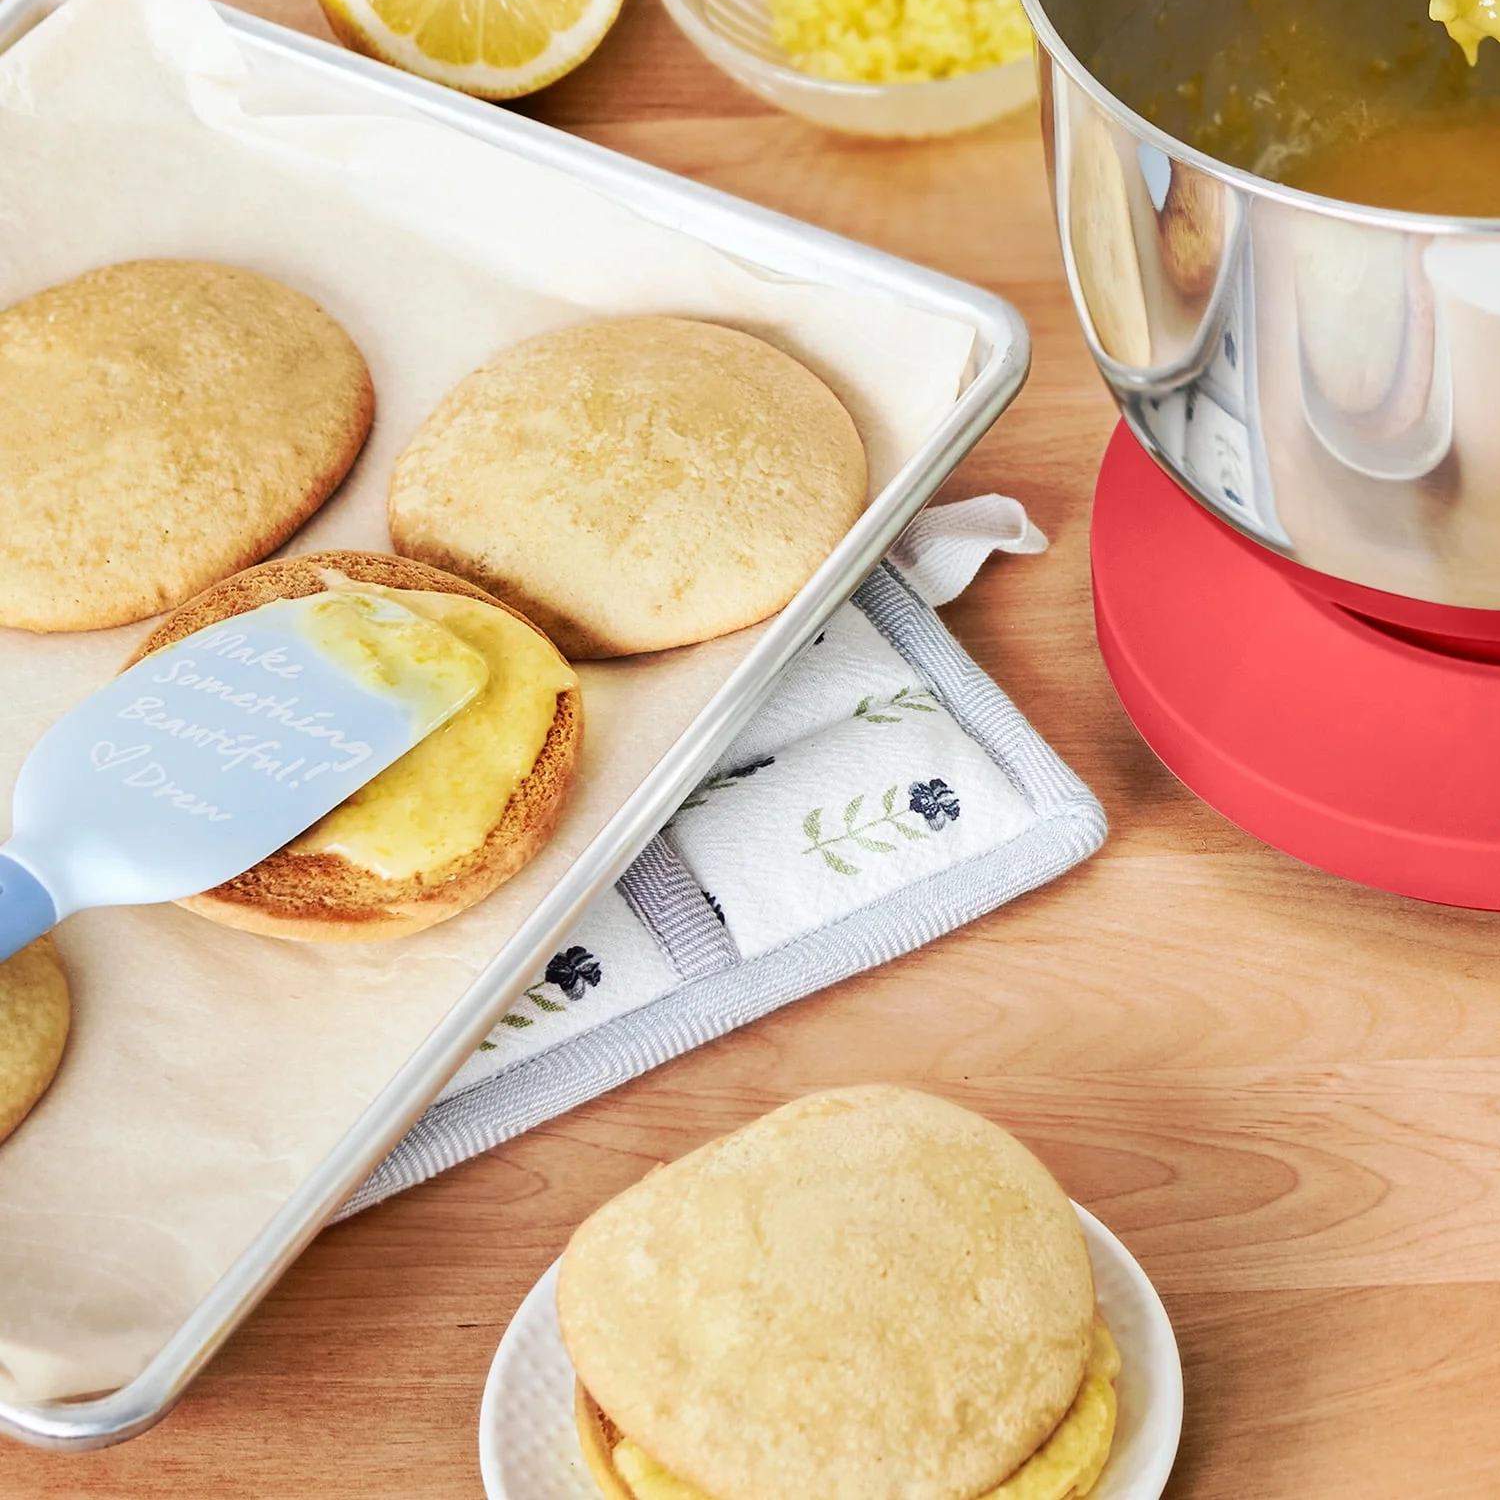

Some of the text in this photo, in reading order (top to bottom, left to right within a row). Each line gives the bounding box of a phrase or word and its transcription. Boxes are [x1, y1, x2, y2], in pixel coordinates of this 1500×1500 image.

[193, 629, 304, 679] Make
[116, 696, 331, 790] Beautiful!
[151, 658, 374, 773] Something
[122, 761, 233, 823] Drew
